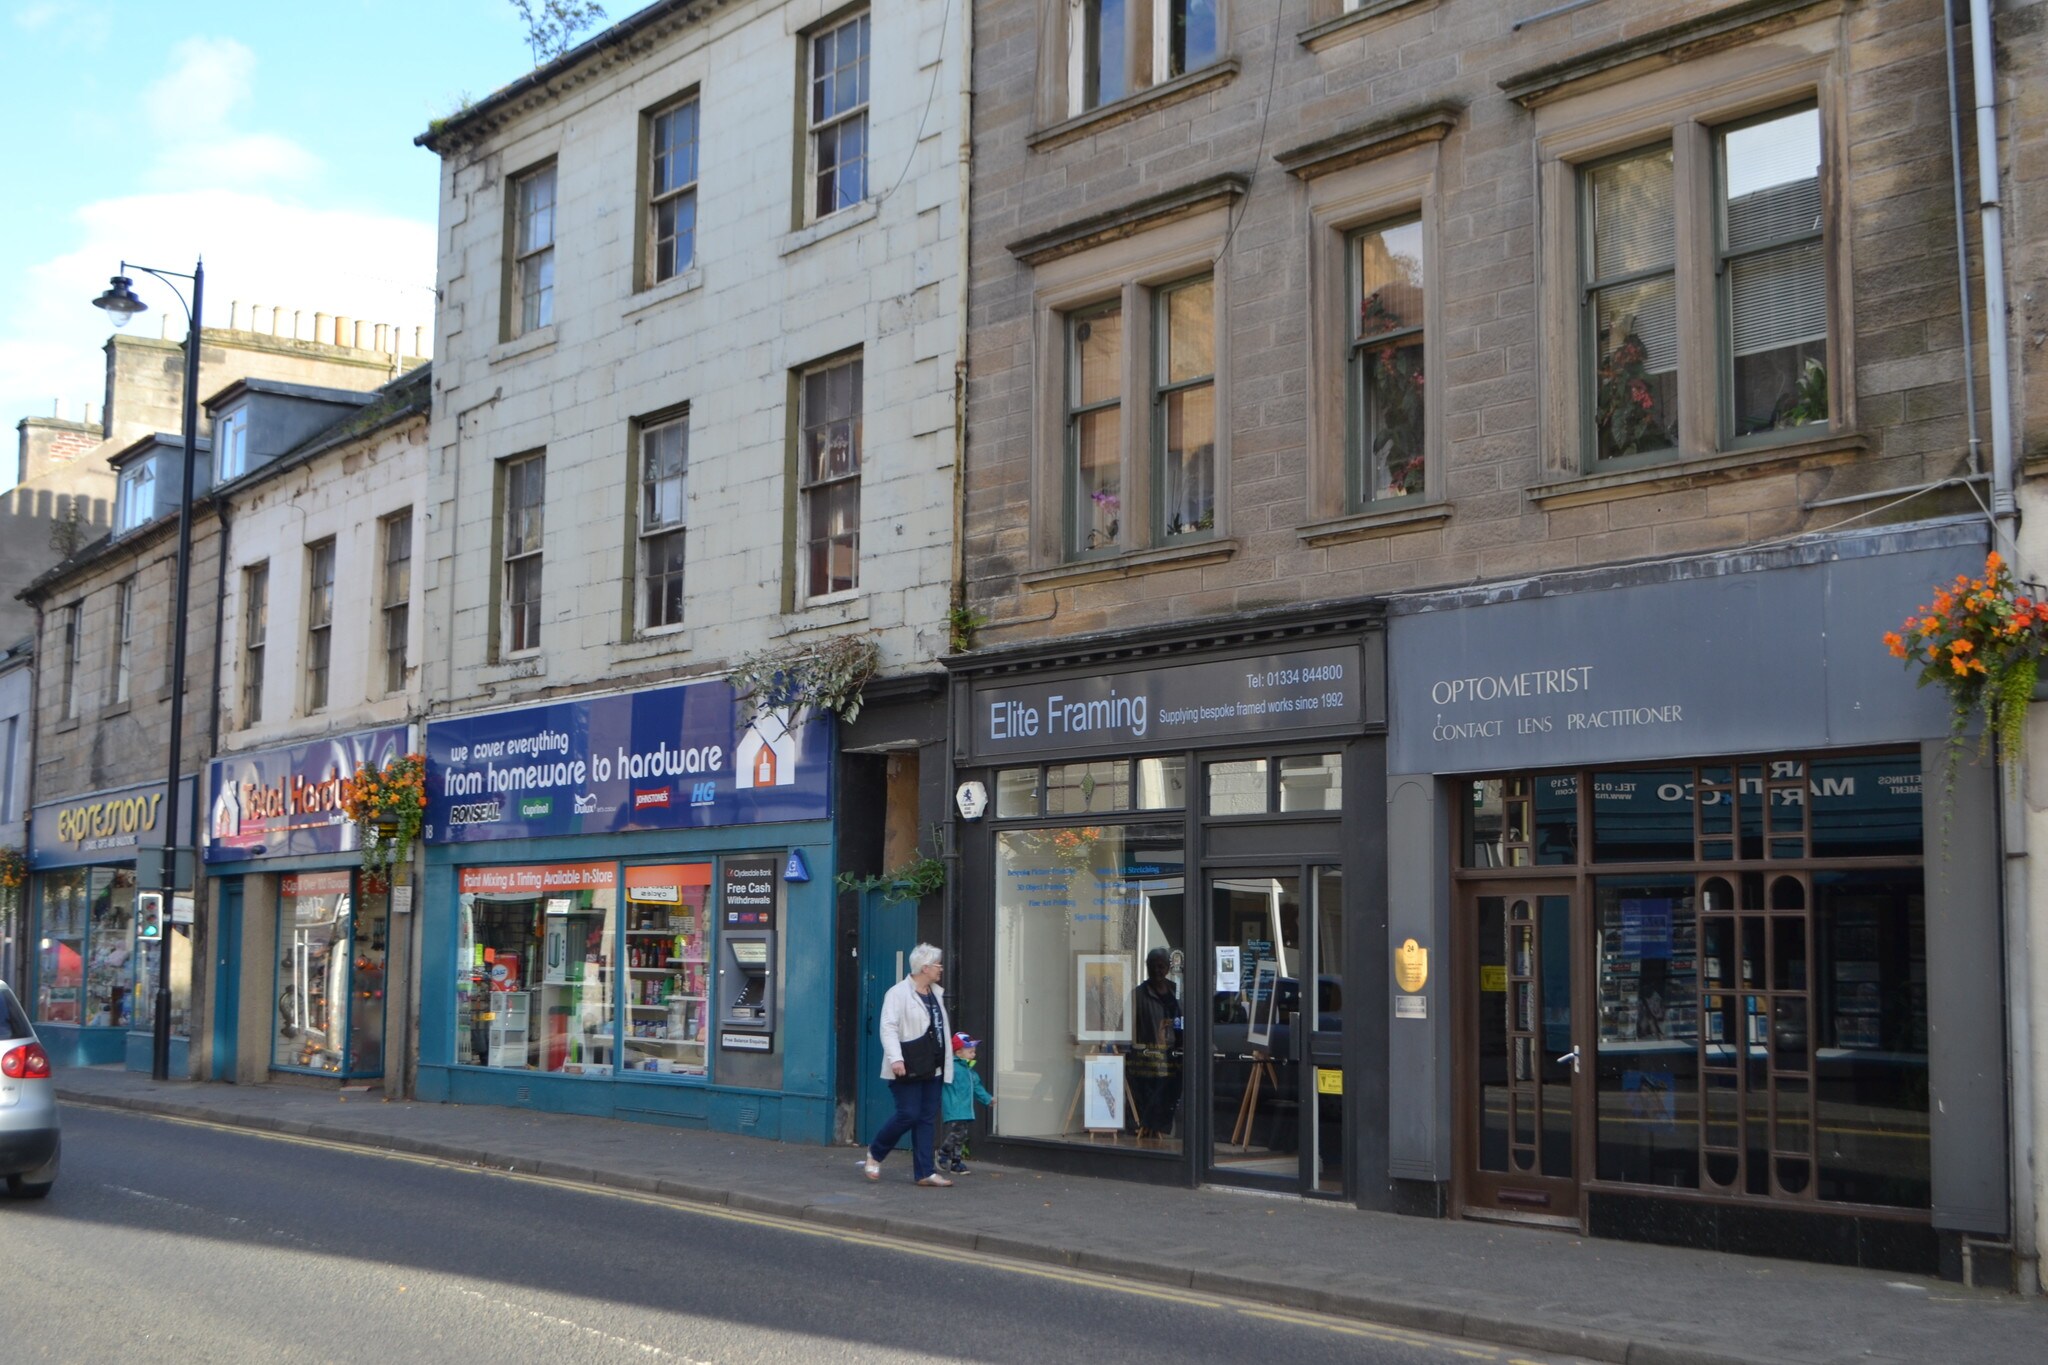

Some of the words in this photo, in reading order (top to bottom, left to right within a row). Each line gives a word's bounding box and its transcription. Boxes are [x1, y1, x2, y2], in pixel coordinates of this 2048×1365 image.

[1246, 674, 1264, 688] Tel:
[1267, 669, 1299, 686] 01334
[1302, 664, 1343, 683] 844800
[1432, 666, 1593, 704] OPTOMETRIST
[991, 701, 1039, 739] Elite
[1048, 689, 1147, 736] Framing
[1159, 707, 1198, 725] Supplying
[1200, 703, 1235, 721] bespoke
[1237, 700, 1266, 715] framed
[1268, 699, 1293, 713] works
[1295, 696, 1318, 710] since
[1321, 692, 1343, 707] 1992
[1433, 720, 1504, 741] CONTACT
[1518, 716, 1553, 735] LENS
[1567, 705, 1683, 730] PRACTITIONER
[451, 746, 468, 762] we
[473, 741, 505, 759] cover
[507, 730, 569, 758] everything
[444, 767, 482, 796] from
[487, 760, 586, 793] homeware
[592, 754, 611, 782] to
[618, 741, 722, 780] hardware
[243, 776, 286, 820] Total
[692, 781, 716, 803] HG
[450, 802, 500, 825] RONSEAL
[522, 803, 549, 817] Cuprinol
[574, 803, 594, 814] Dulux
[425, 825, 433, 839] 18
[464, 873, 481, 887] Paint
[482, 872, 507, 889] Mixing
[509, 874, 515, 886] &
[517, 871, 542, 889] Tinting
[543, 869, 580, 885] Available
[582, 868, 614, 883] In-Store
[733, 869, 760, 878] Clydesdale
[760, 869, 772, 877] Bank
[727, 883, 747, 893] Free
[748, 882, 771, 893] Cash
[727, 896, 771, 904] Withdrawals
[1407, 945, 1414, 953] 24
